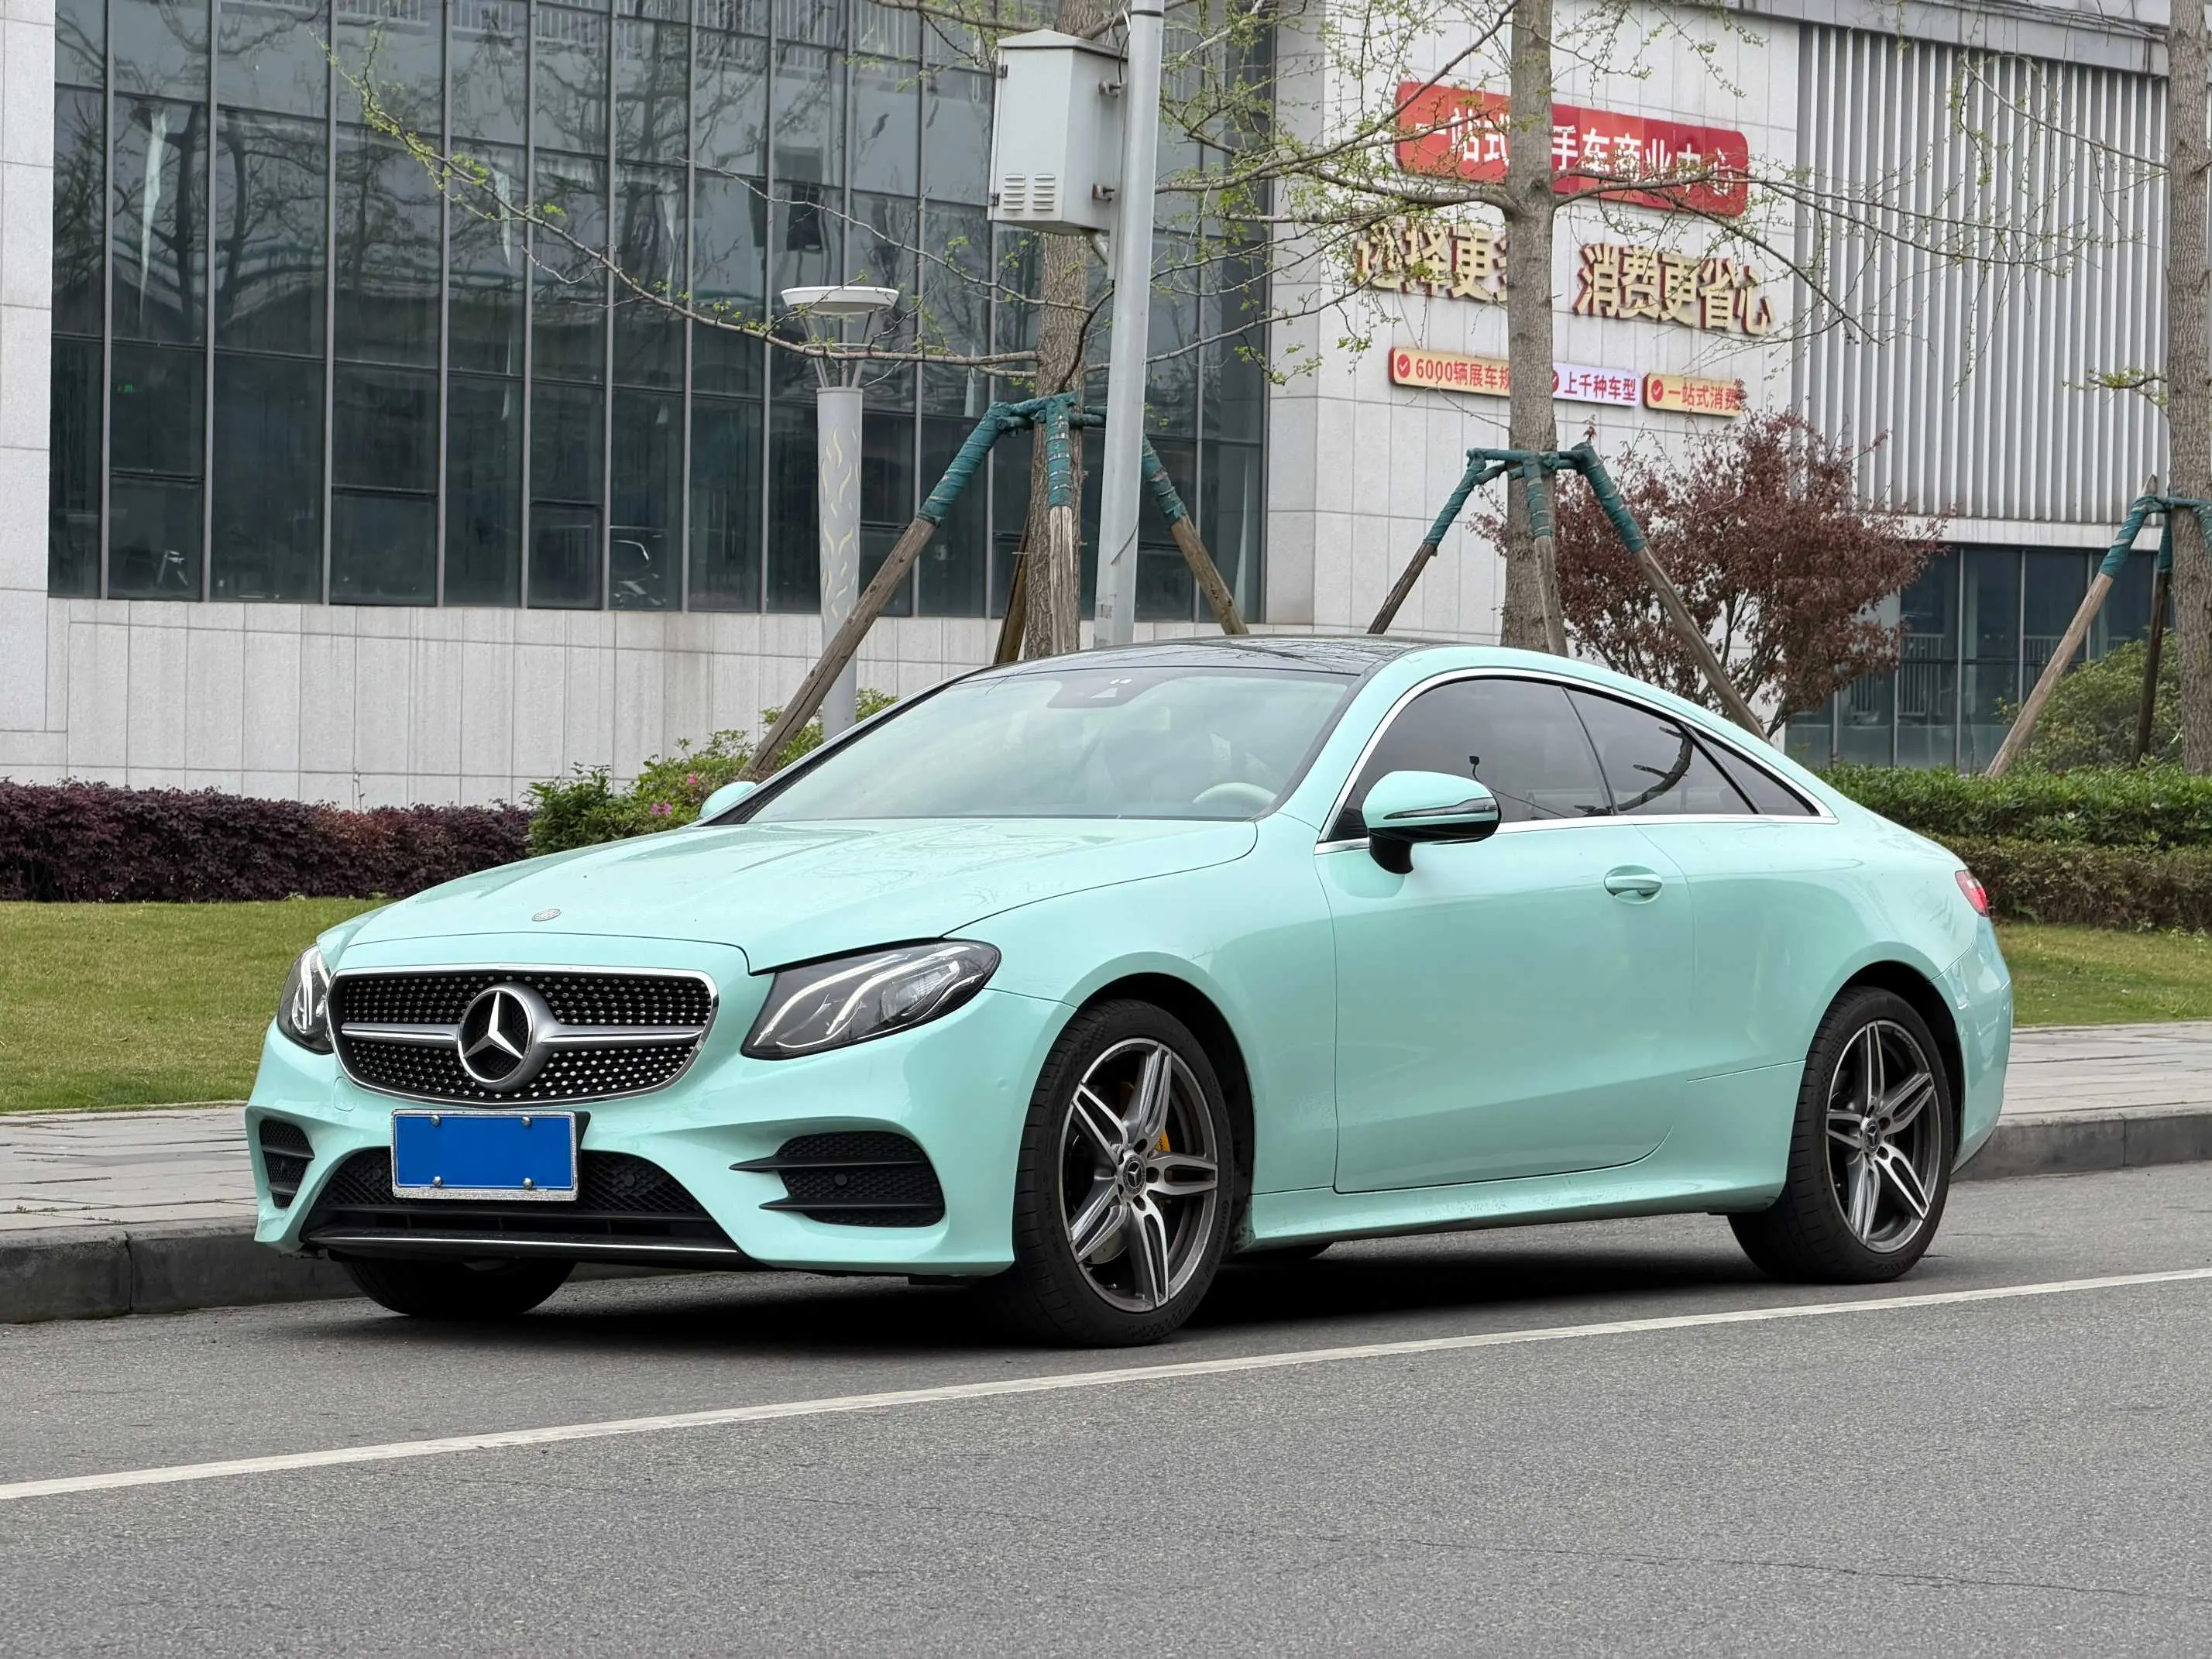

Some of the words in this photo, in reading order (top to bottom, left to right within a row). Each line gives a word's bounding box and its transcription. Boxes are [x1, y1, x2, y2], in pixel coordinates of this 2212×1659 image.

[1415, 107, 1735, 195] 一站式手车商业中心
[1572, 242, 1774, 336] 消费更省心
[1564, 371, 1636, 402] 上千种车型
[1668, 381, 1740, 410] 一站式消费
